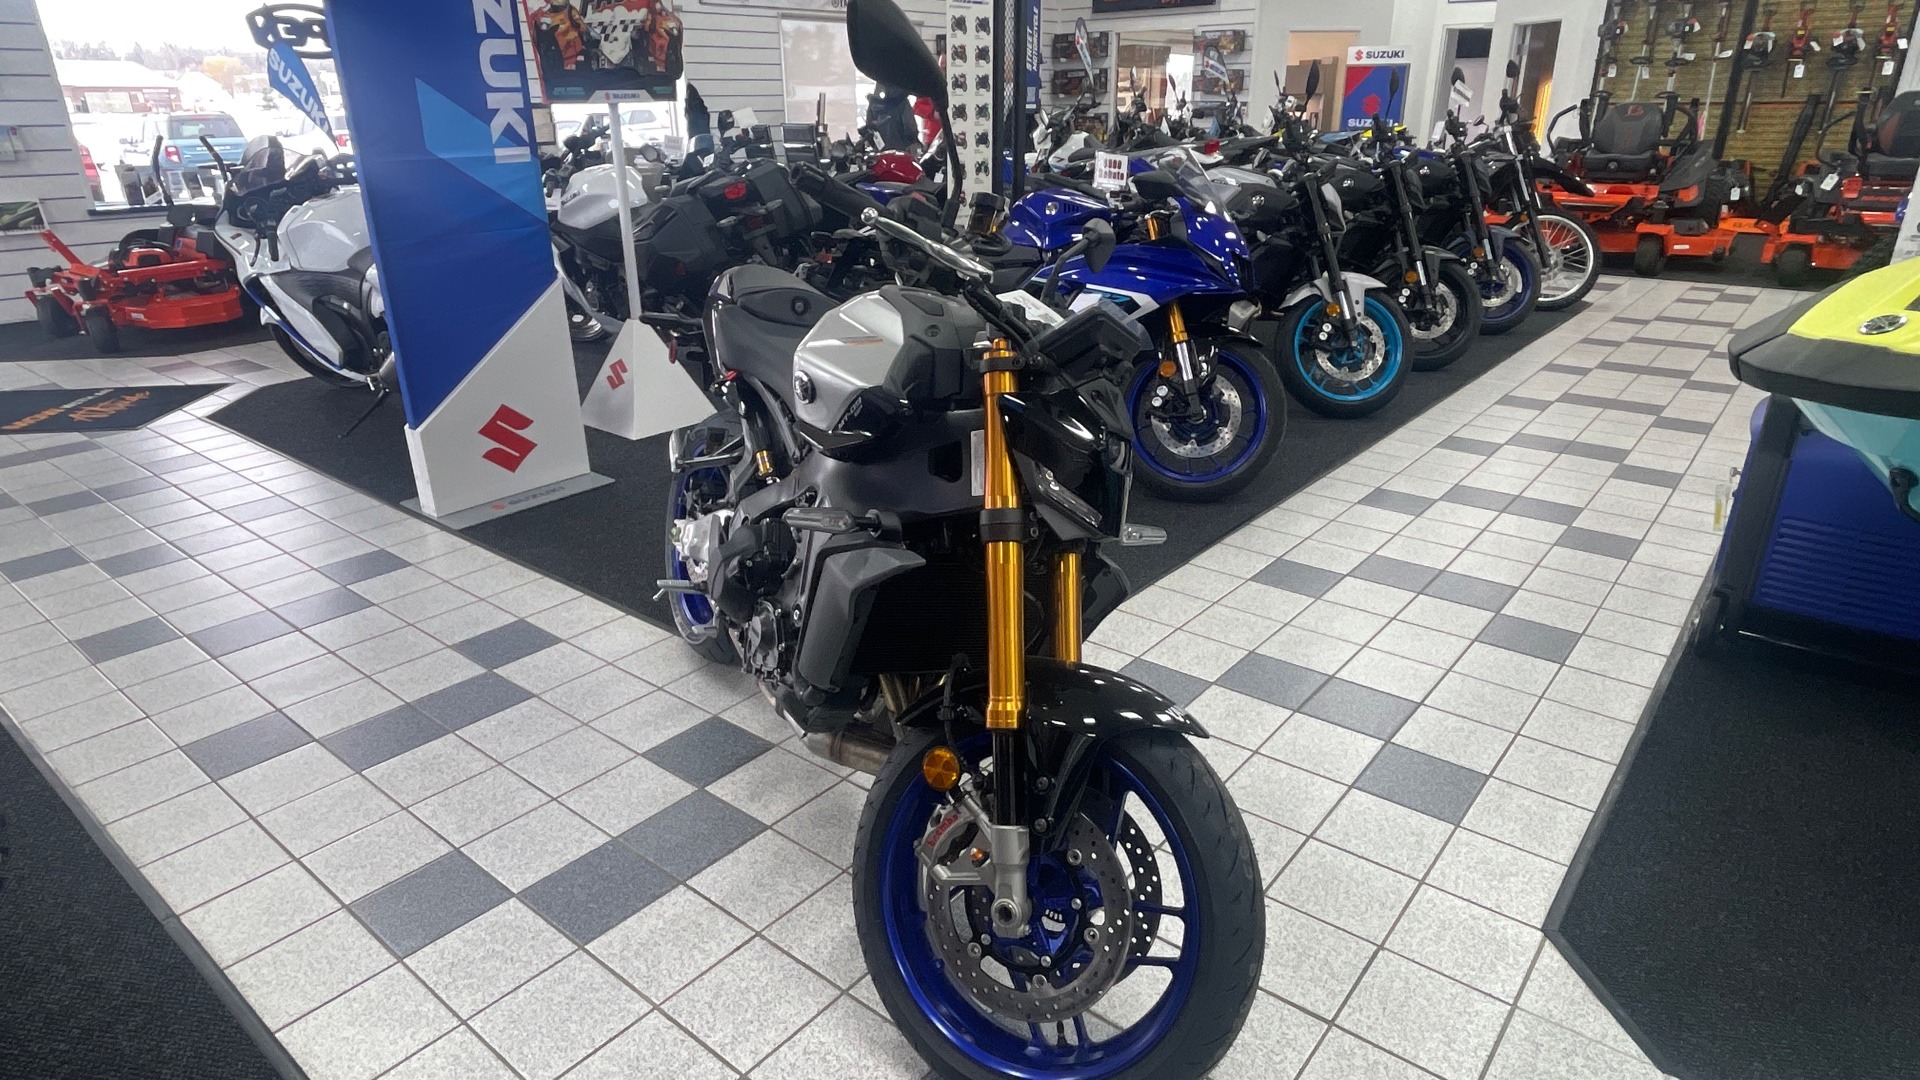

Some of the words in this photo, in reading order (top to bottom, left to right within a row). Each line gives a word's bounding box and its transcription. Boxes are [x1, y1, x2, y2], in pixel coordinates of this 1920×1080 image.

[1366, 50, 1405, 59] SUZUKI
[268, 48, 329, 133] SUZUKI
[1347, 118, 1394, 127] SUZI
